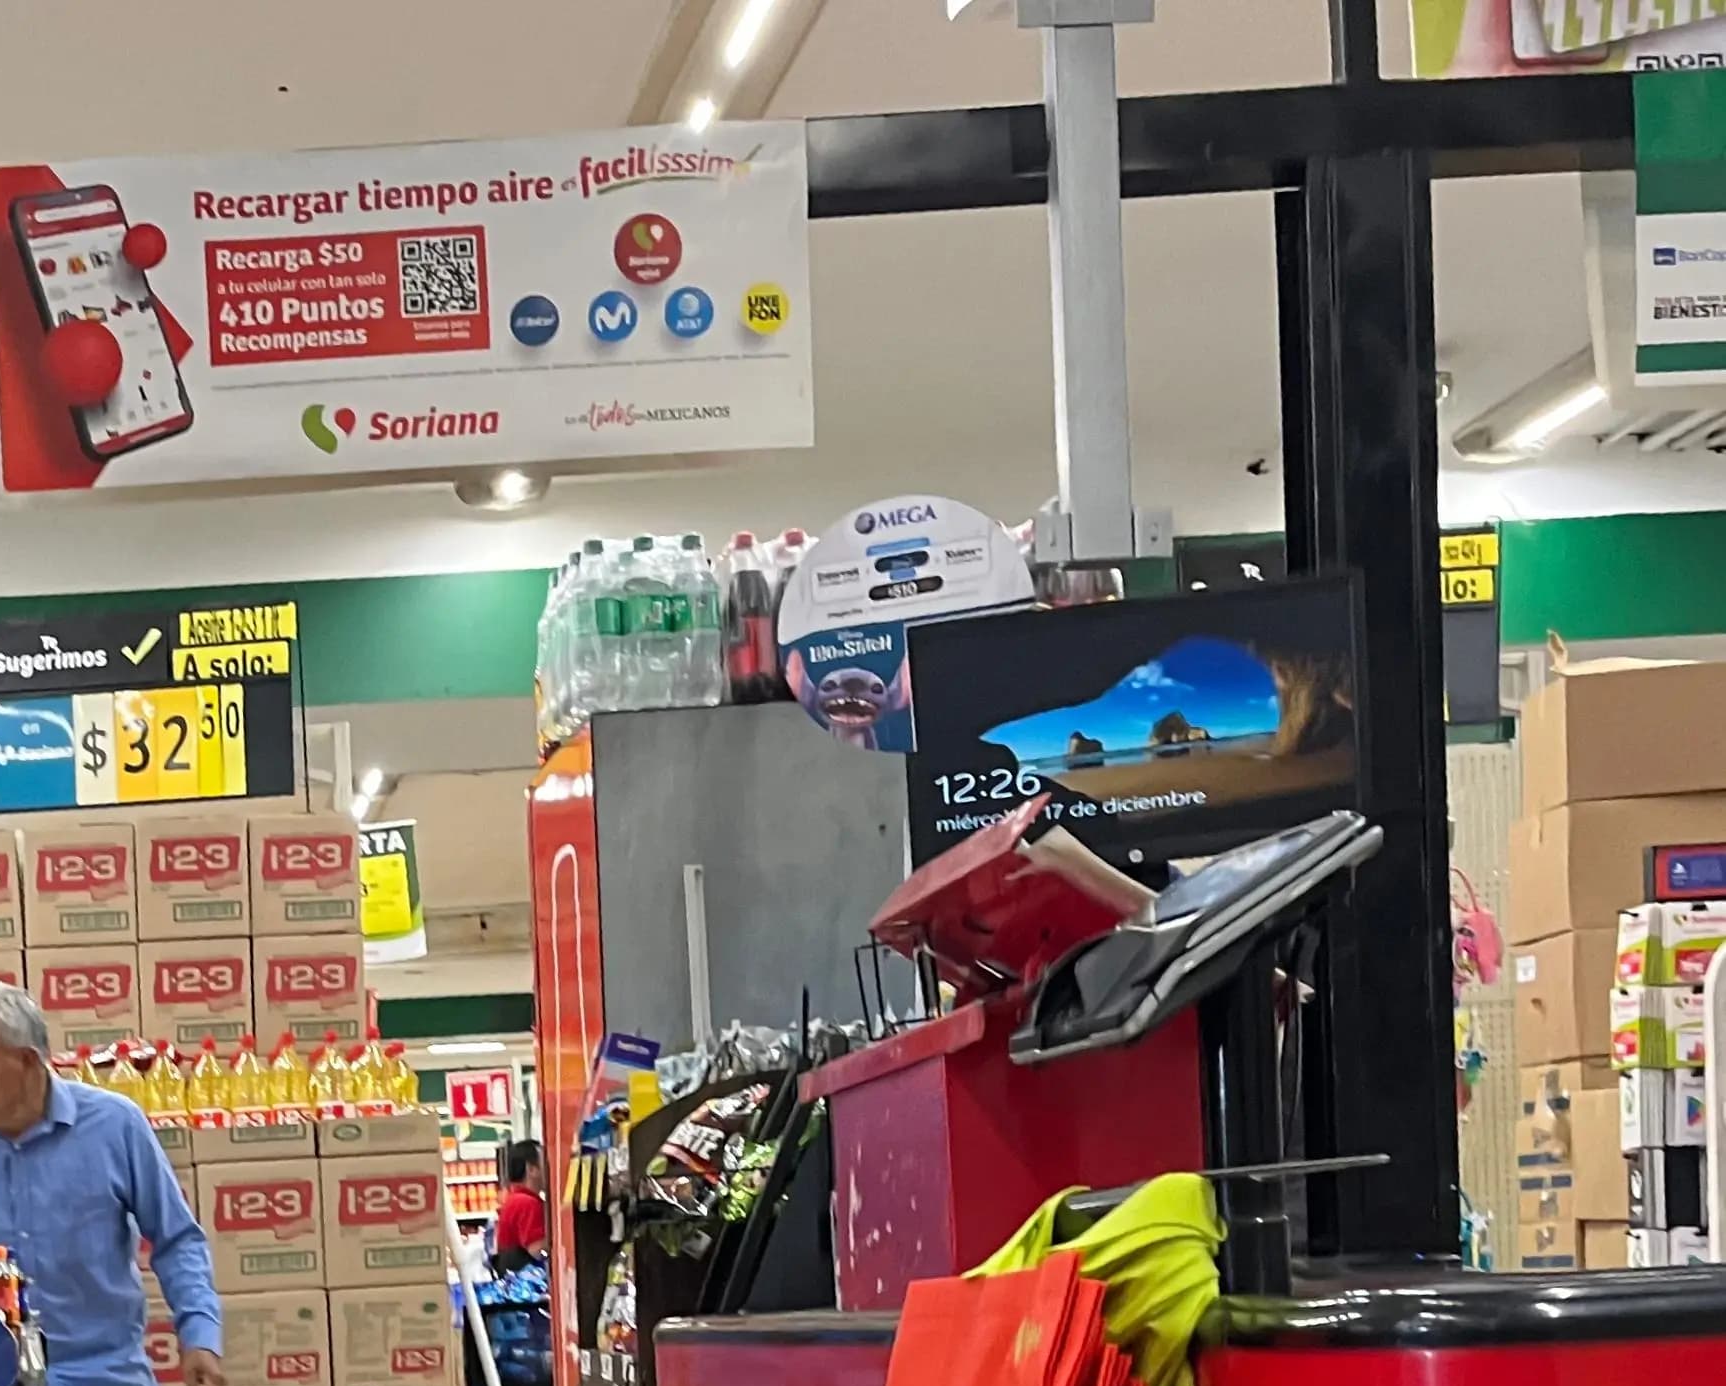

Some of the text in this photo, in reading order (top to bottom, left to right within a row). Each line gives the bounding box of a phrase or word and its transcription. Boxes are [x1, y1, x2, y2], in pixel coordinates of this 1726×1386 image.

[193, 188, 349, 225] Recargar
[357, 180, 479, 215] tiempo
[487, 170, 554, 204] aire
[215, 241, 363, 274] Recarga $50
[217, 271, 387, 296] a tu celular con tan solo
[219, 292, 386, 328] 410 Puntos
[747, 294, 780, 308] UNE
[748, 306, 782, 322] FON
[220, 326, 369, 354] Recompensas
[369, 405, 499, 441] Soriana
[647, 405, 731, 422] MEXICANOS
[877, 504, 938, 530] MEGA
[182, 649, 274, 681] A solo:
[933, 766, 1042, 806] 12:26
[1045, 803, 1061, 820] 17
[1069, 799, 1097, 819] de
[1102, 788, 1207, 814] diciembre
